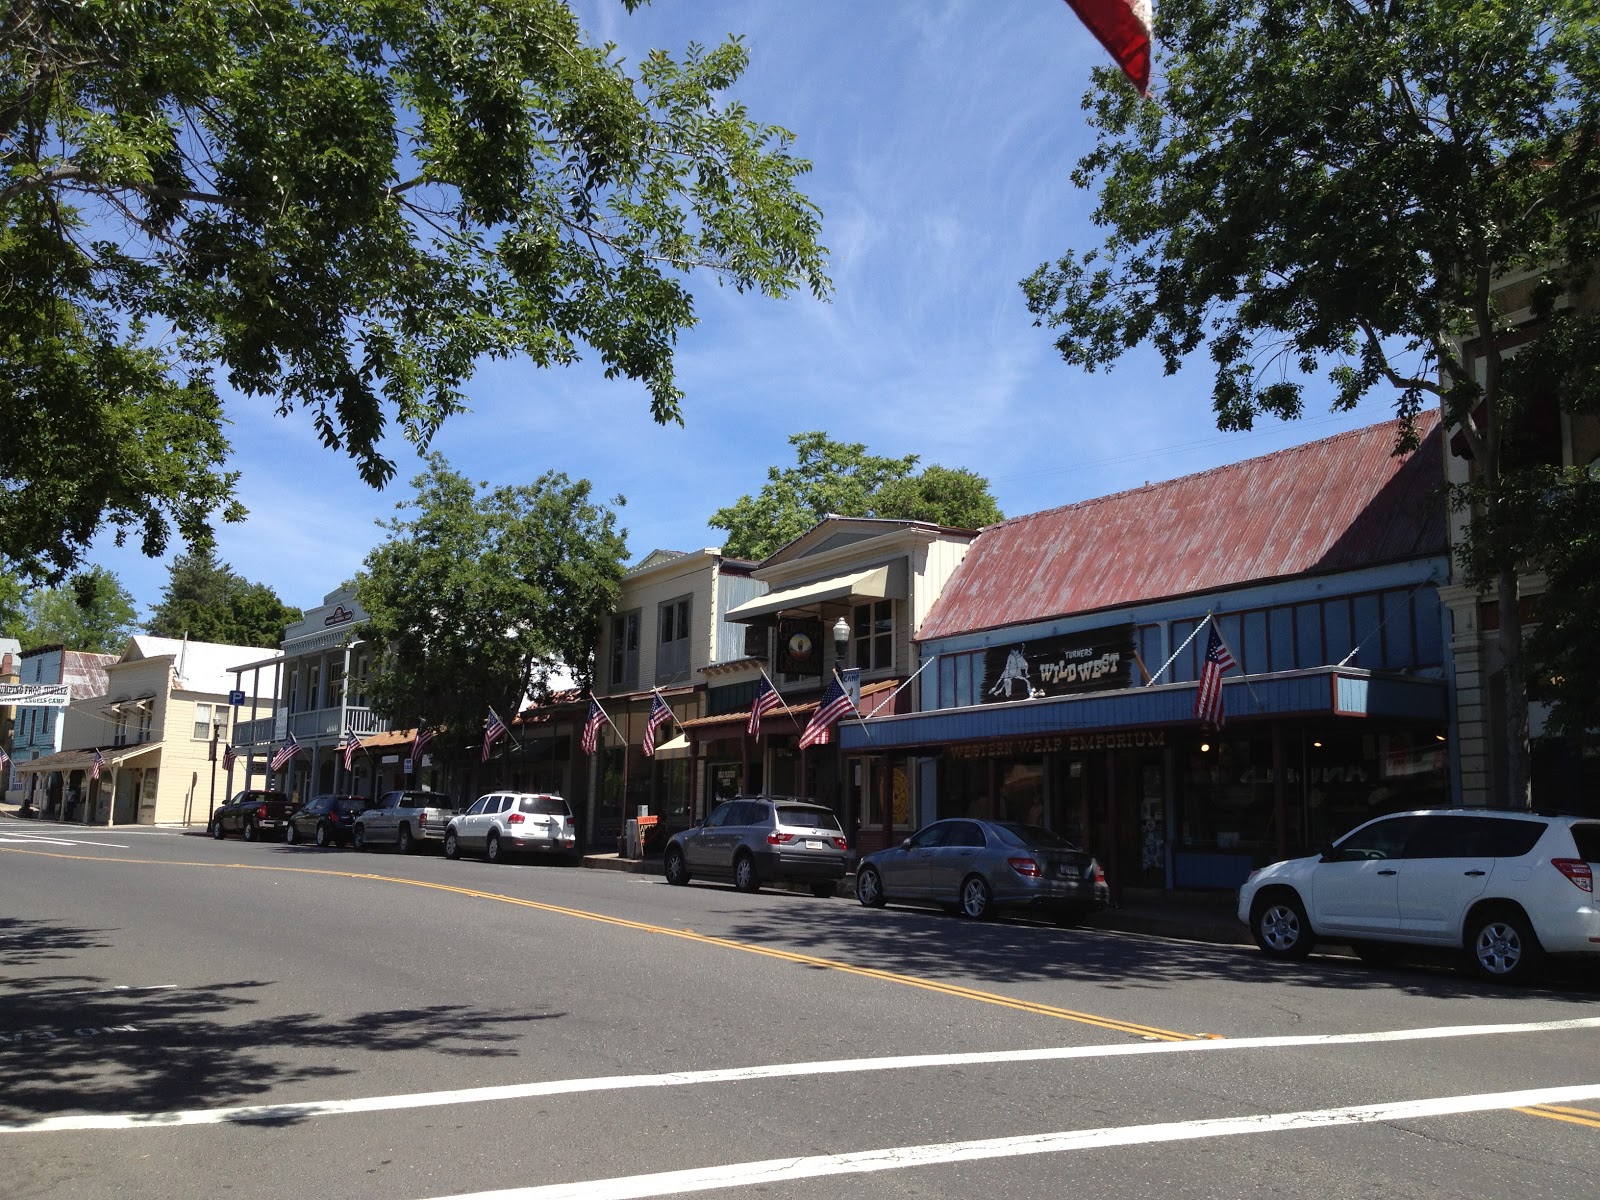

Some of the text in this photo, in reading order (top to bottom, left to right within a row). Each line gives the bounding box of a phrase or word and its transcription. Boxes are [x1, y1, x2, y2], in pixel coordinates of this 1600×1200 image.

[1065, 648, 1093, 659] TURNERS
[1040, 652, 1120, 683] WILD WEST
[843, 674, 860, 683] CAMP
[232, 692, 243, 705] P
[950, 731, 1166, 760] WESTERN WEAR EMPORIUM
